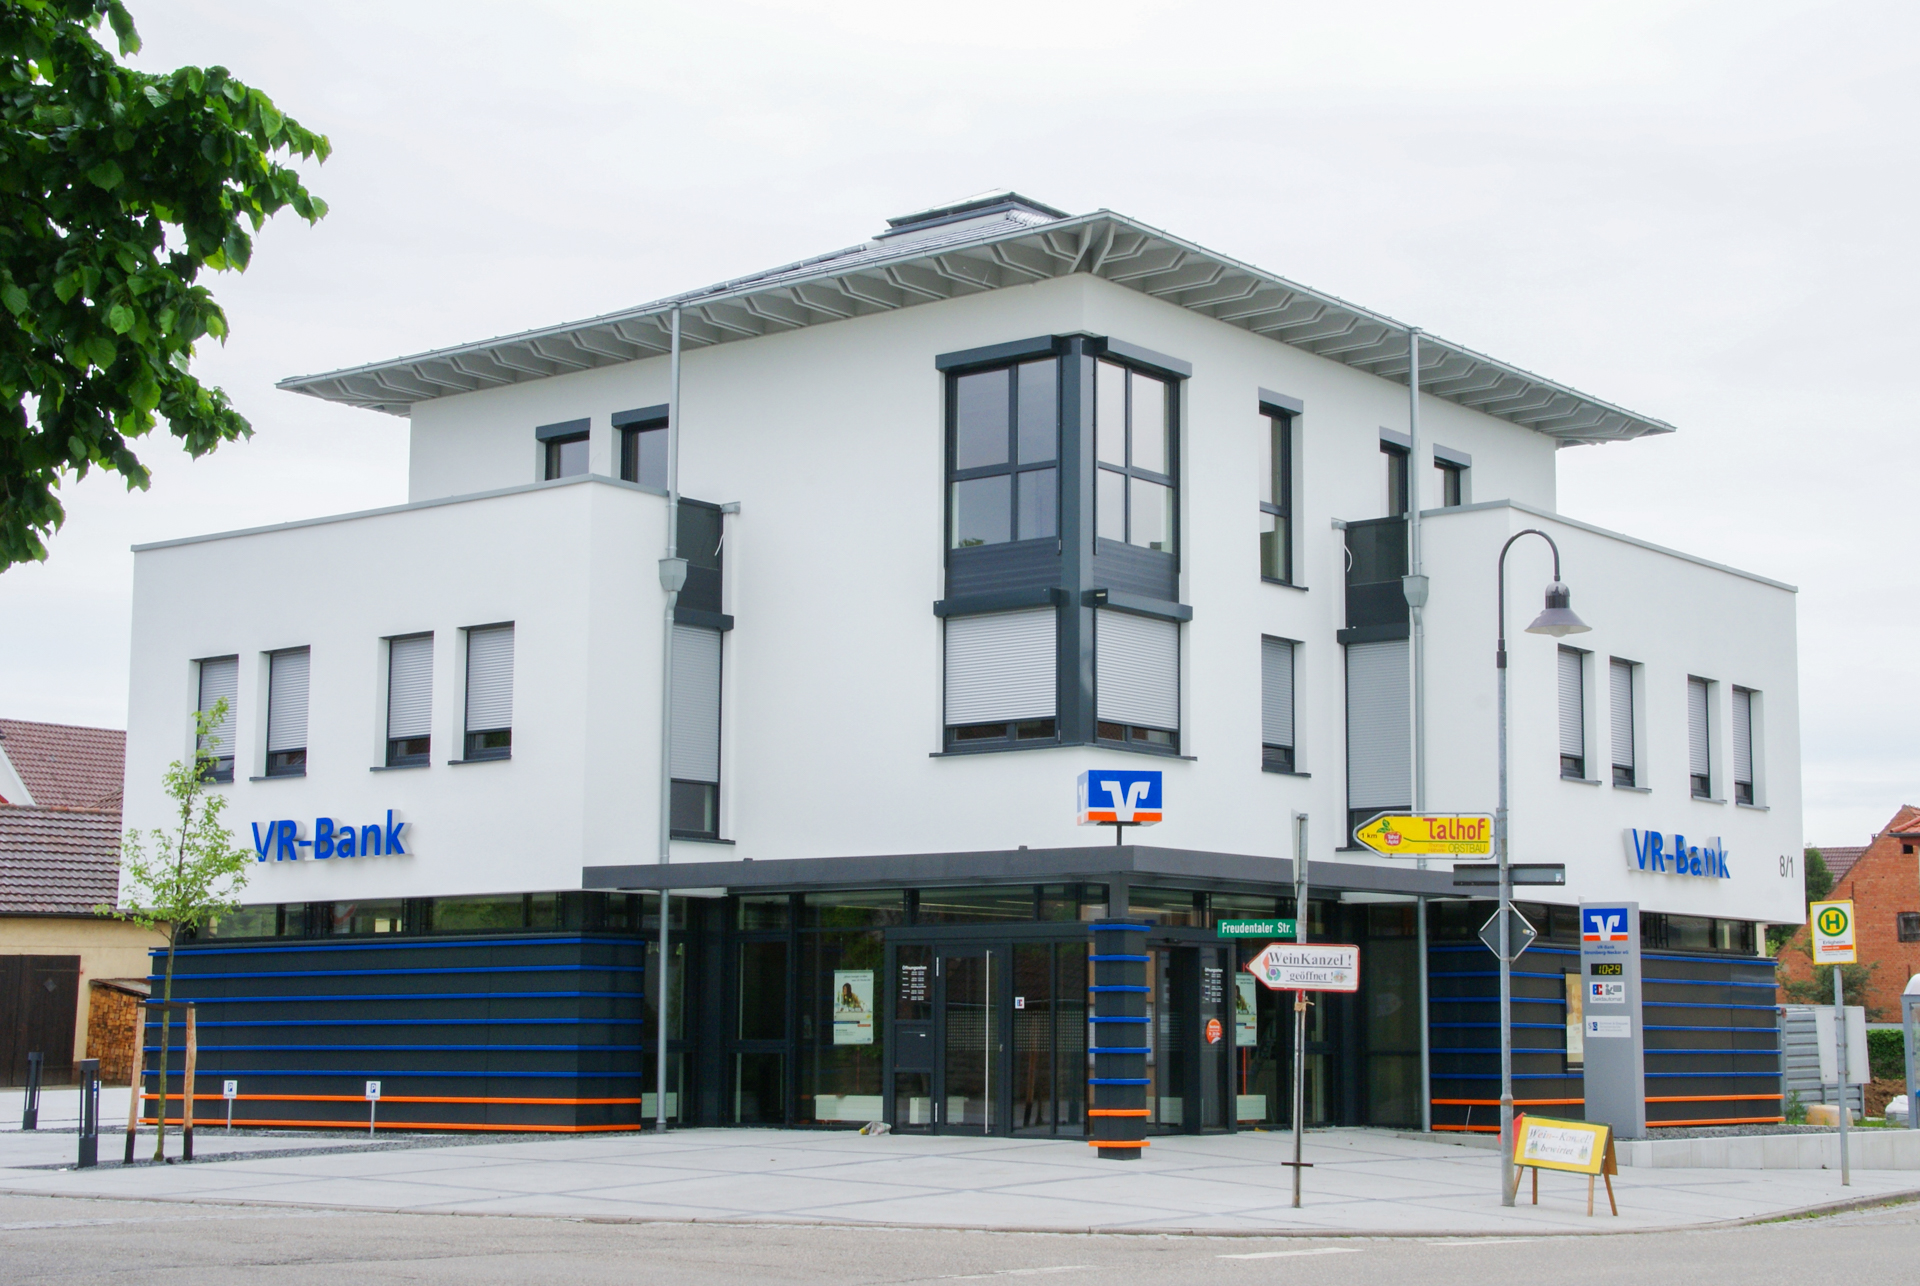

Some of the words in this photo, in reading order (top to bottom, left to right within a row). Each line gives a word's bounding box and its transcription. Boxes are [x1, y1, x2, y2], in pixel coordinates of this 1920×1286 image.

[252, 809, 406, 863] VR-Bank
[1422, 818, 1486, 840] Talhof
[1448, 843, 1486, 853] OBSTBAU
[1630, 828, 1731, 879] VR-Bank
[1779, 855, 1794, 878] 8/1
[1222, 922, 1274, 934] Freudentaler
[1277, 922, 1292, 934] Str.
[1825, 913, 1841, 930] H
[1268, 952, 1344, 966] WeinKanzel
[1540, 1143, 1574, 1156] bewirtet
